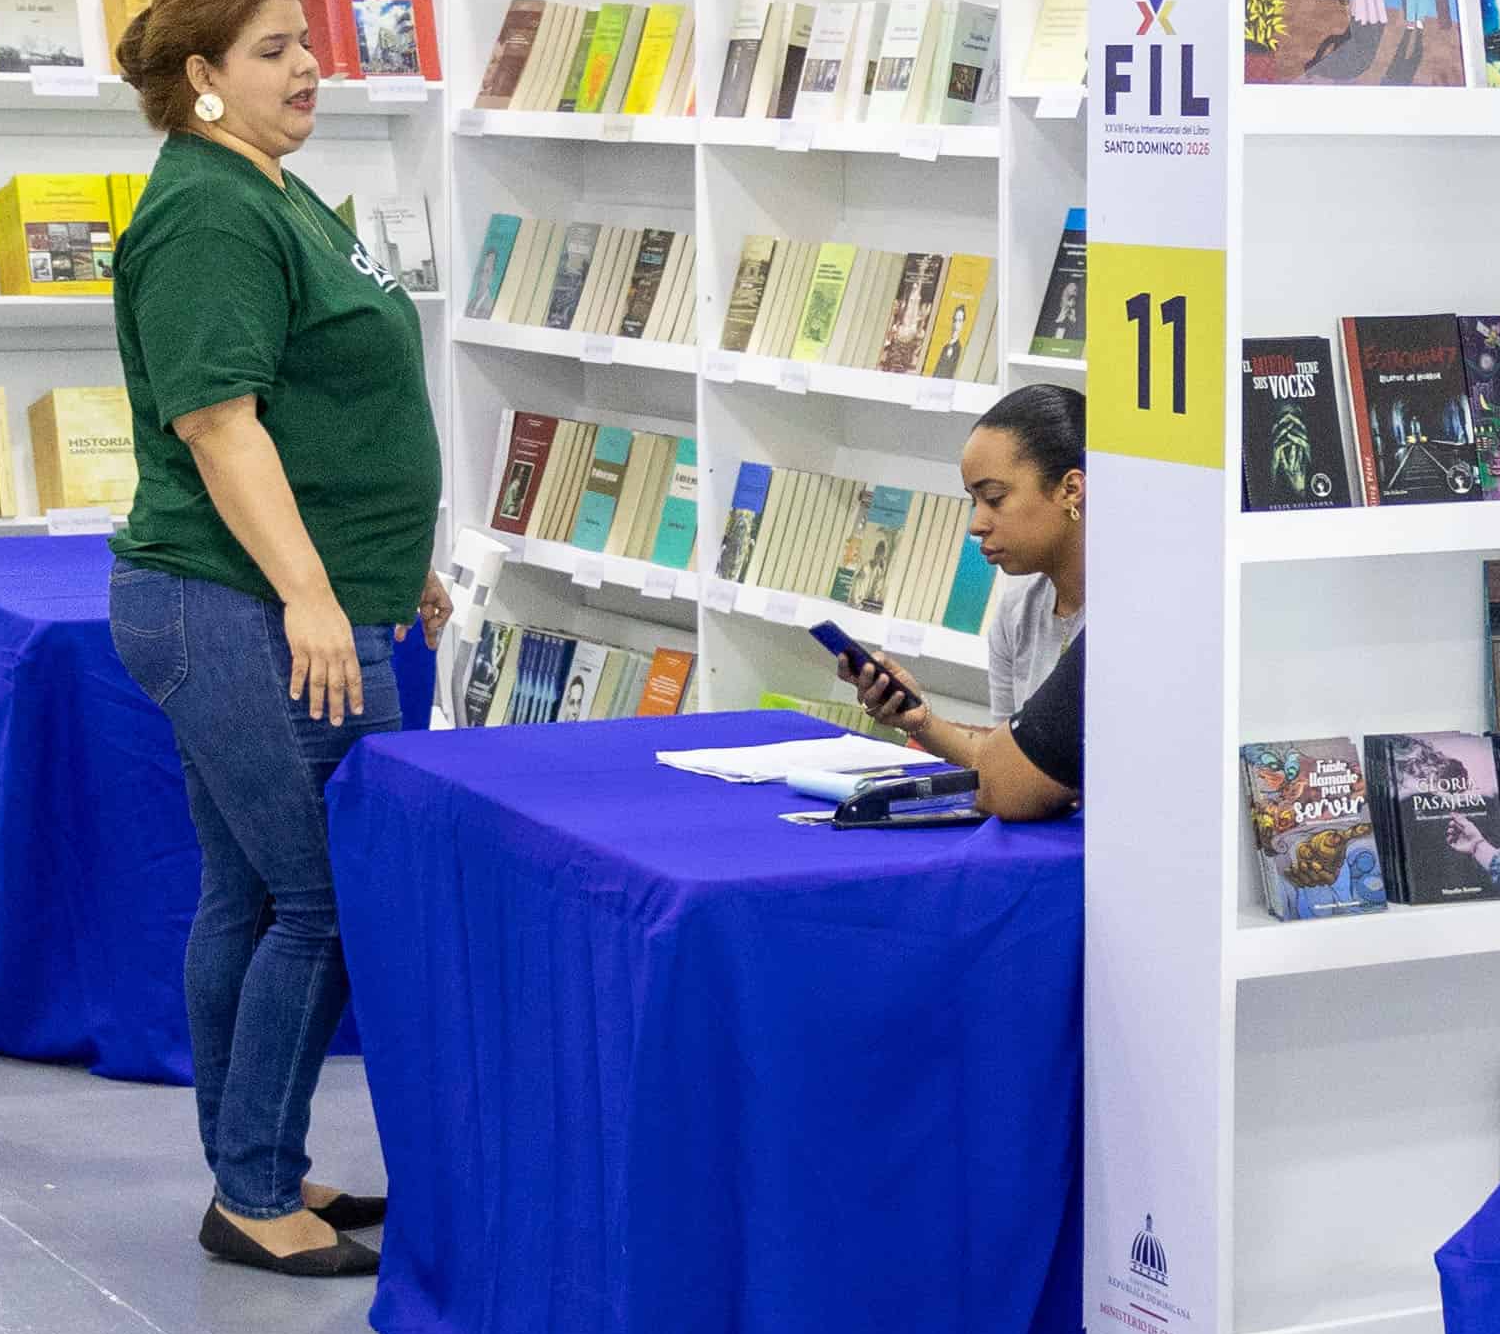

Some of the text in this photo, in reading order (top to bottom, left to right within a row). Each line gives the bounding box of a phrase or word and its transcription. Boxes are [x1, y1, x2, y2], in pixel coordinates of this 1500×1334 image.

[1104, 44, 1210, 117] FIL
[1104, 140, 1211, 156] SANTO DOMINGO 2026
[1125, 292, 1188, 417] 11
[1295, 361, 1320, 374] TIENE
[1268, 374, 1316, 399] VOCES
[68, 437, 132, 448] HISTORIA
[1309, 770, 1360, 788] llamado
[1414, 777, 1478, 794] GLORIA
[1321, 784, 1351, 799] para
[1293, 795, 1365, 823] servir
[1411, 794, 1487, 812] PASAJERA
[1099, 1301, 1146, 1334] MINISTERIO
